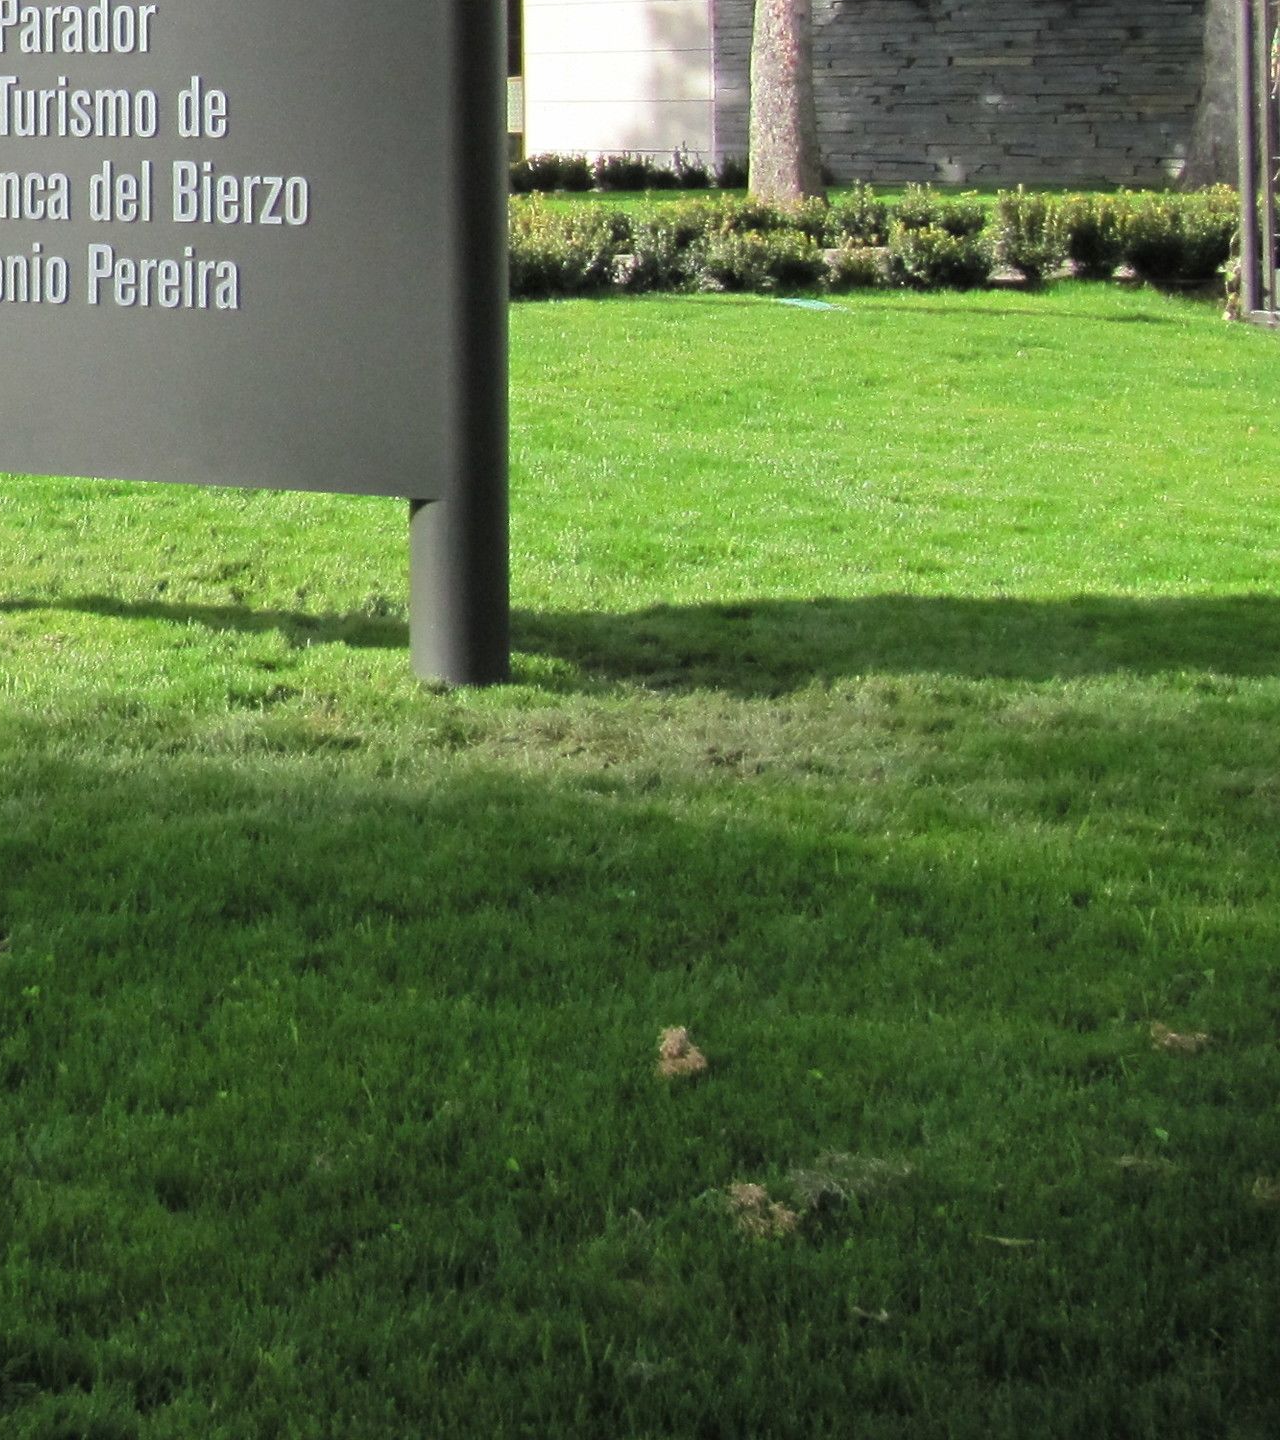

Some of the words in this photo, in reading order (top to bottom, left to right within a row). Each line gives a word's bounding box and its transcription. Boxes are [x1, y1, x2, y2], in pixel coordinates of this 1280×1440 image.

[177, 75, 228, 139] de
[89, 159, 151, 223] del
[172, 160, 309, 227] Bierzo
[87, 243, 239, 311] Pereira
